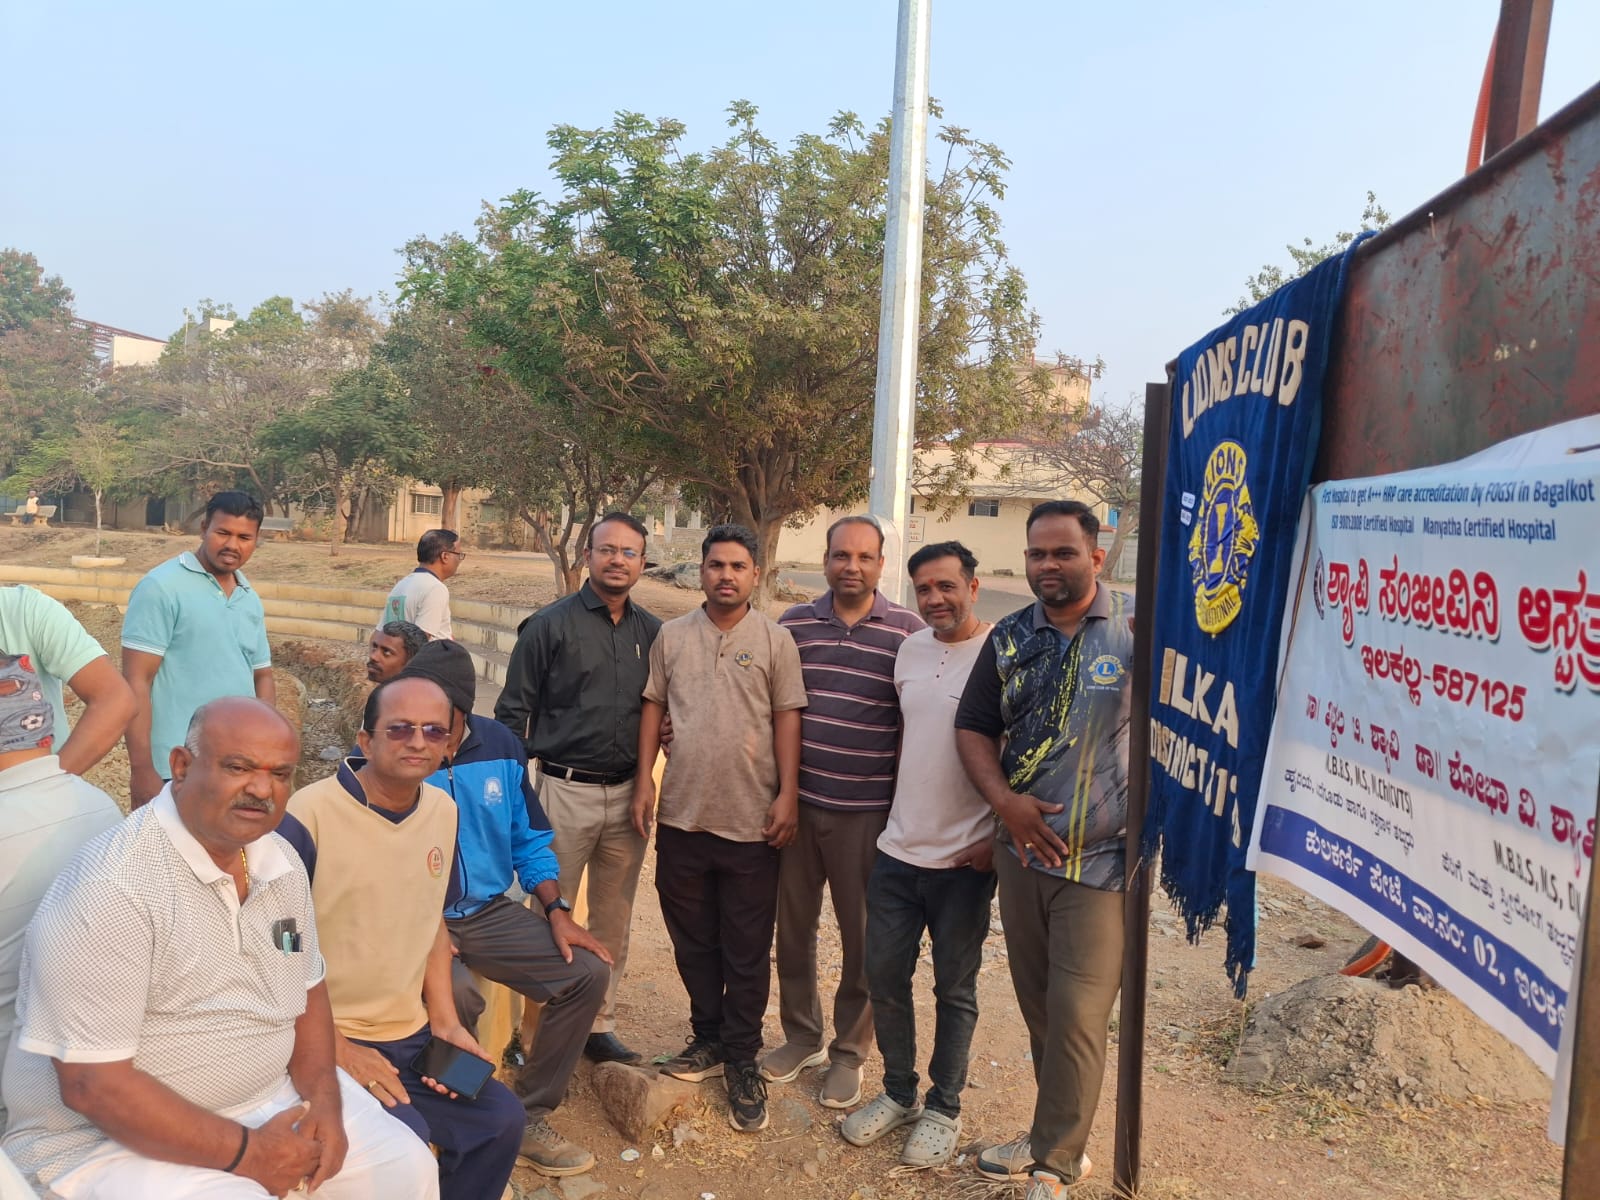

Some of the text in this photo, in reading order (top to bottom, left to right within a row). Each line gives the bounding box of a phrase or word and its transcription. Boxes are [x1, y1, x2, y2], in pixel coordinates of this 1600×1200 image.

[1182, 317, 1310, 440] LIONS CLUB
[1398, 488, 1413, 503] care
[1413, 483, 1469, 503] accreditation
[1470, 482, 1484, 507] by
[1518, 480, 1530, 502] in
[1534, 479, 1595, 508] Bagalkot
[1422, 517, 1462, 539] Manyatha
[1464, 518, 1505, 538] Certified
[1508, 518, 1556, 544] Hospital
[1378, 554, 1499, 636] ಸಂಜೀವಿನಿ
